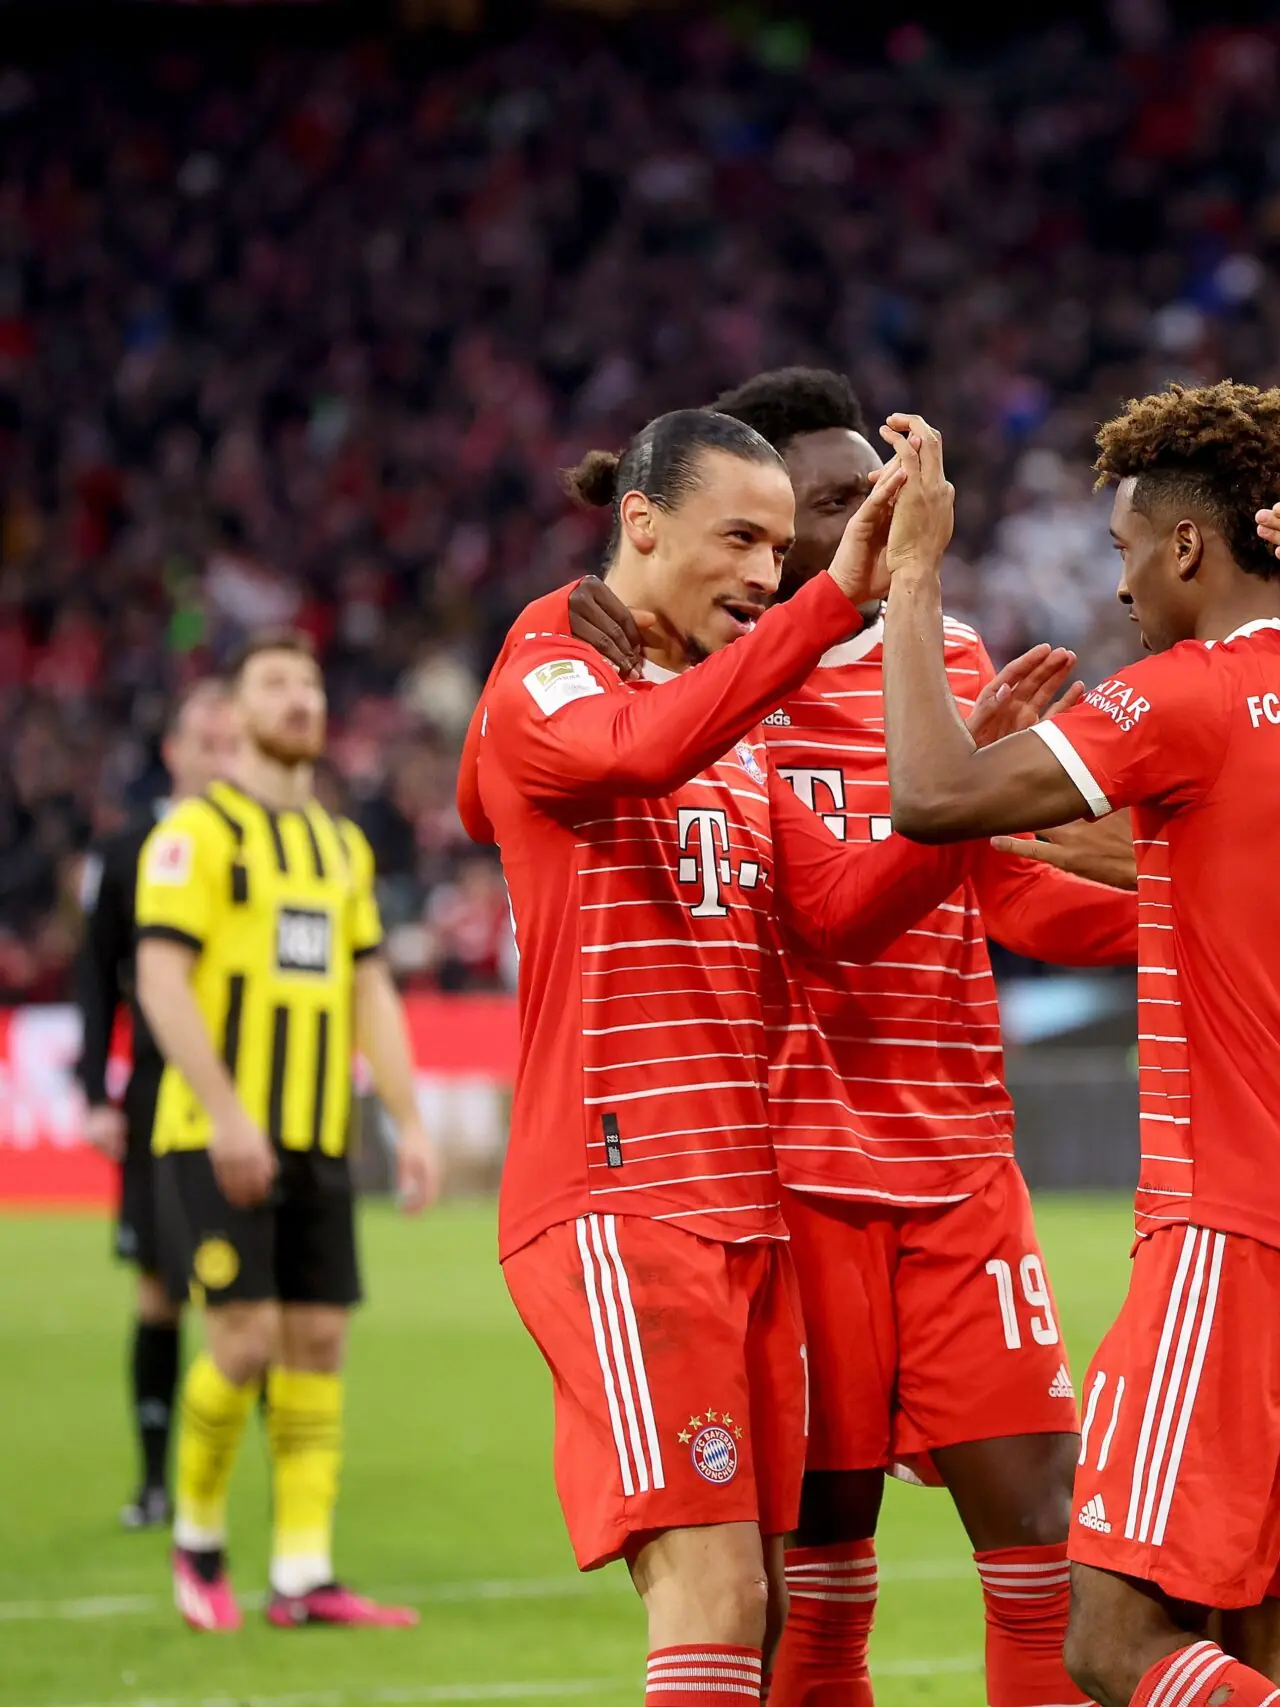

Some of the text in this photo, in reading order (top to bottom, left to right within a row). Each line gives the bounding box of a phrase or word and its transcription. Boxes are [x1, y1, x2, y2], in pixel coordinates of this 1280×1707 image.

[1083, 691, 1135, 732] IRWAYS
[1094, 679, 1151, 722] ATAR
[985, 1253, 1059, 1350] 19
[695, 1430, 733, 1453] FC BAYERN
[1077, 1370, 1126, 1472] 11
[1078, 1513, 1112, 1534] adidas
